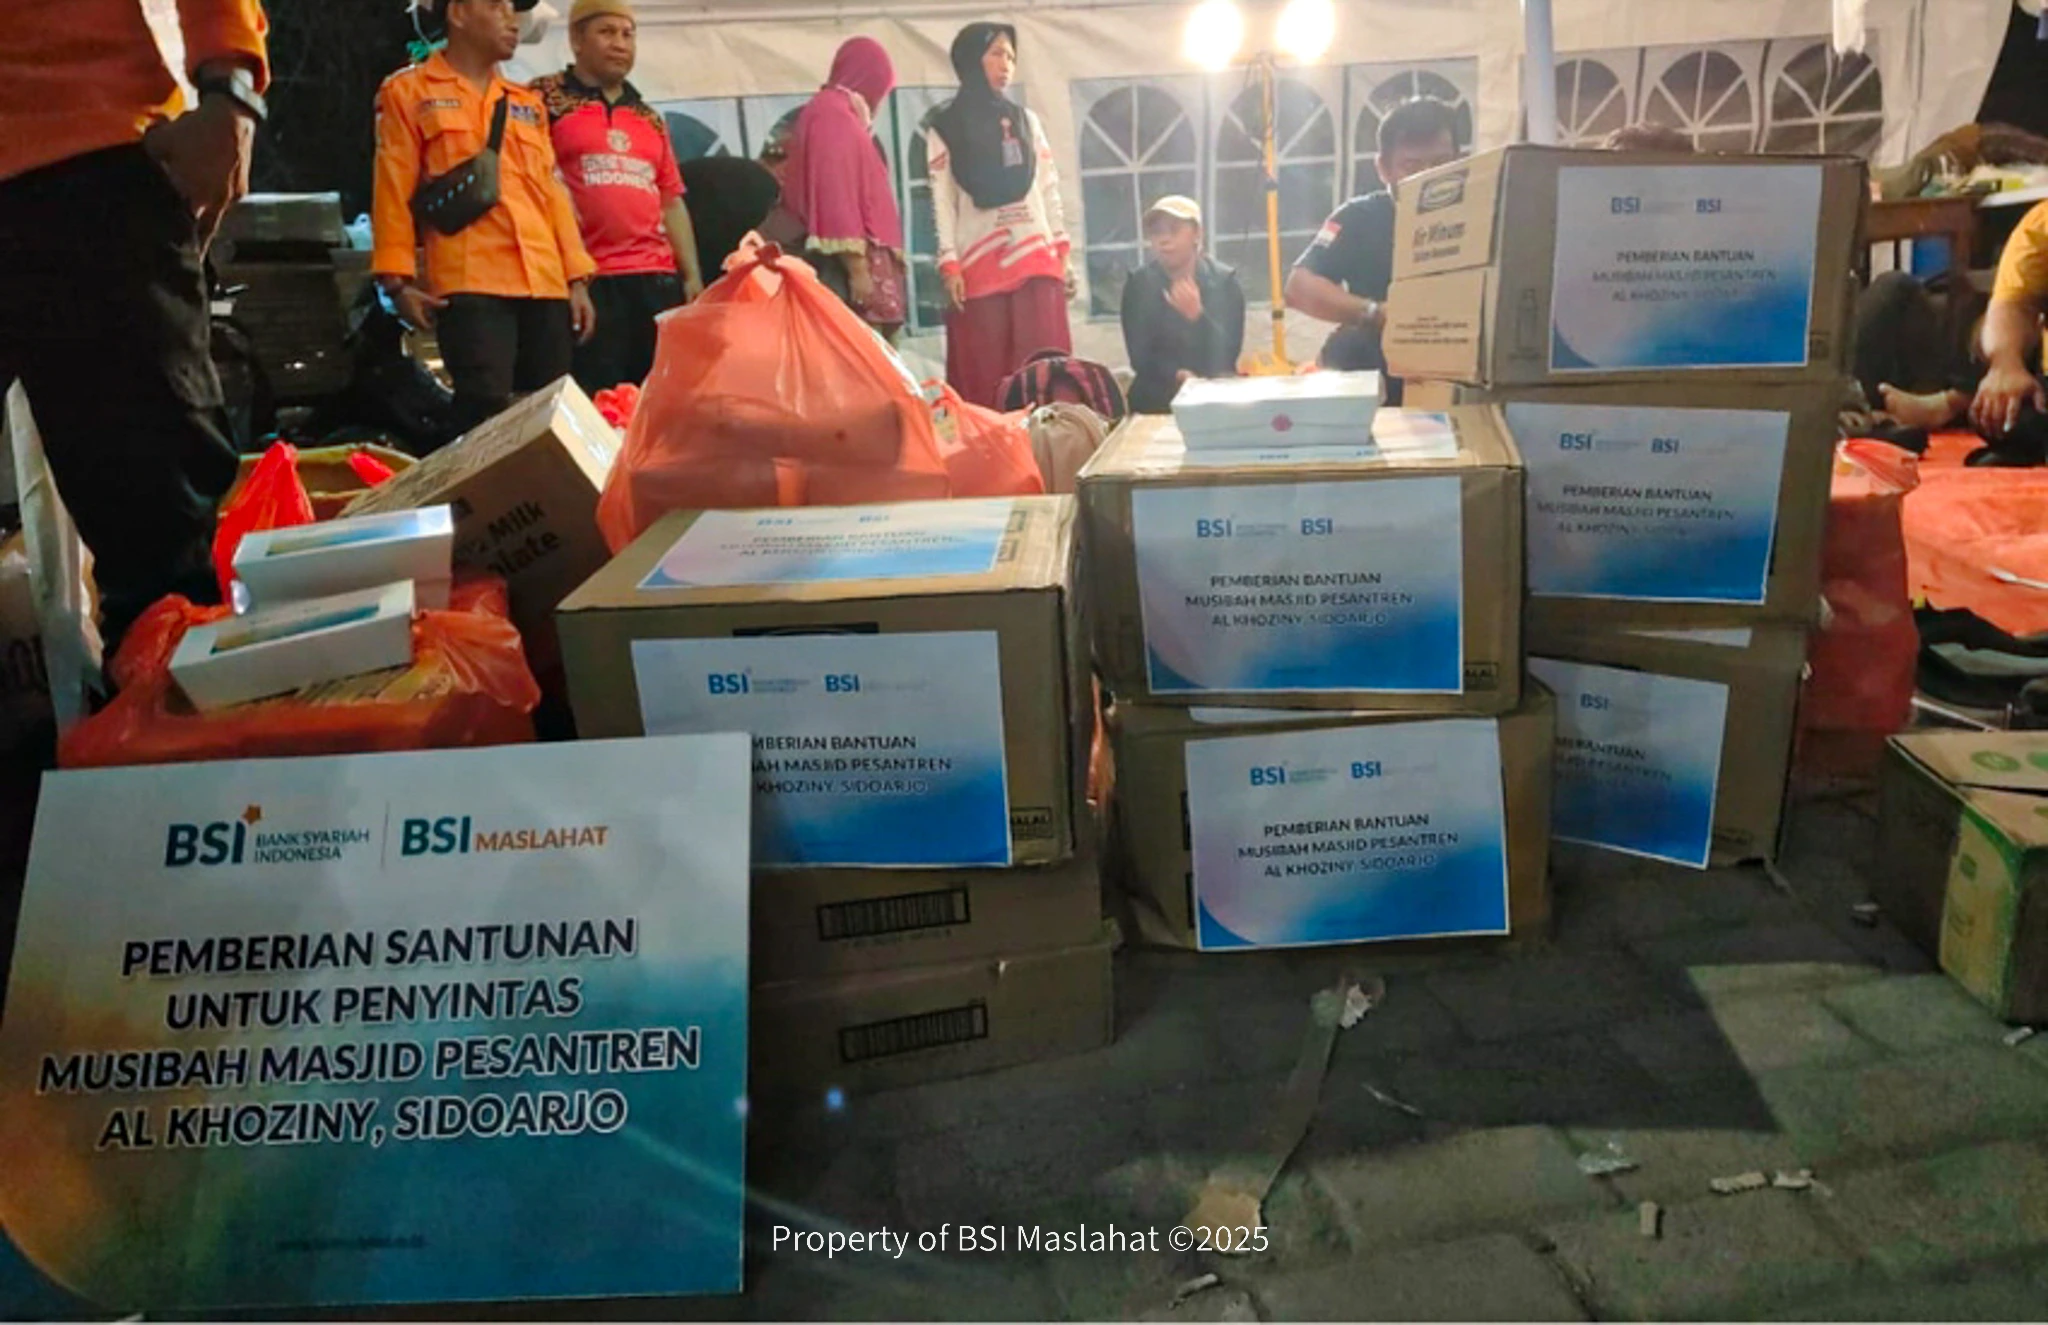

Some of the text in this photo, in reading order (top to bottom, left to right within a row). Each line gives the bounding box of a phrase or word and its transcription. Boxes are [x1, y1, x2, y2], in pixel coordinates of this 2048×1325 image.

[1559, 433, 1593, 451] BSI
[1651, 438, 1680, 453] BSI
[1562, 484, 1712, 502] PEMBERIAN BANTUAN
[1196, 519, 1232, 538] BSI
[1301, 517, 1333, 536] BSI
[1211, 572, 1383, 588] PEMBERIAN BANTUAN
[708, 673, 750, 695] BSI
[824, 673, 861, 693] BSI
[752, 736, 917, 751] MBERIAN BANTUAN
[784, 758, 848, 773] MASJID
[851, 758, 952, 772] PESANTREN
[1250, 766, 1286, 786] BSI
[1351, 761, 1382, 779] BSI
[1264, 813, 1430, 837] PEMBERIAN BANTUAN
[165, 815, 609, 867] BSI BANK SYARIAH BSI MASLAHAT
[1311, 838, 1368, 854] MASJID
[1369, 832, 1459, 850] PESANTREN
[254, 846, 342, 864] INDONESIA
[121, 918, 635, 976] PEMBERIAN SANTUNAN
[166, 977, 580, 1029] UNTUK PENYINTAS
[39, 1028, 699, 1092] MUSIBAH MASJID PESANTREN
[99, 1090, 627, 1147] AL KHOZINY, SIDOARJO
